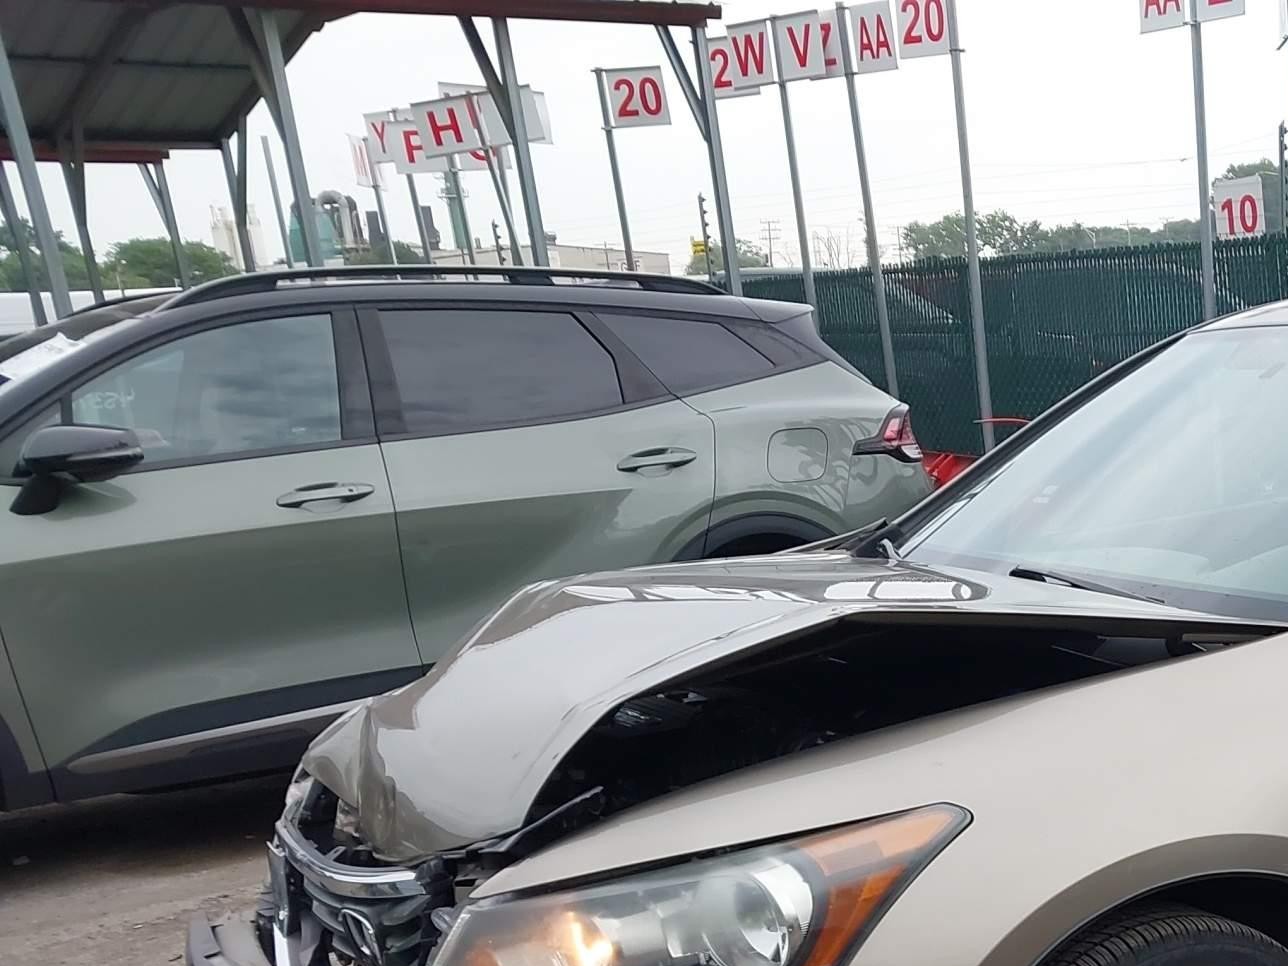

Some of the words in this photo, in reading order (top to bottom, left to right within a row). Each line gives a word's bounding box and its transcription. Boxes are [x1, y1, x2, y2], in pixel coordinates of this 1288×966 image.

[859, 14, 892, 61] AA
[901, 0, 945, 44] 20
[731, 31, 764, 77] W
[786, 23, 810, 68] V
[613, 76, 663, 118] 20
[371, 121, 387, 154] Y
[403, 130, 423, 164] F
[426, 107, 464, 147] H
[1220, 194, 1258, 236] 10
